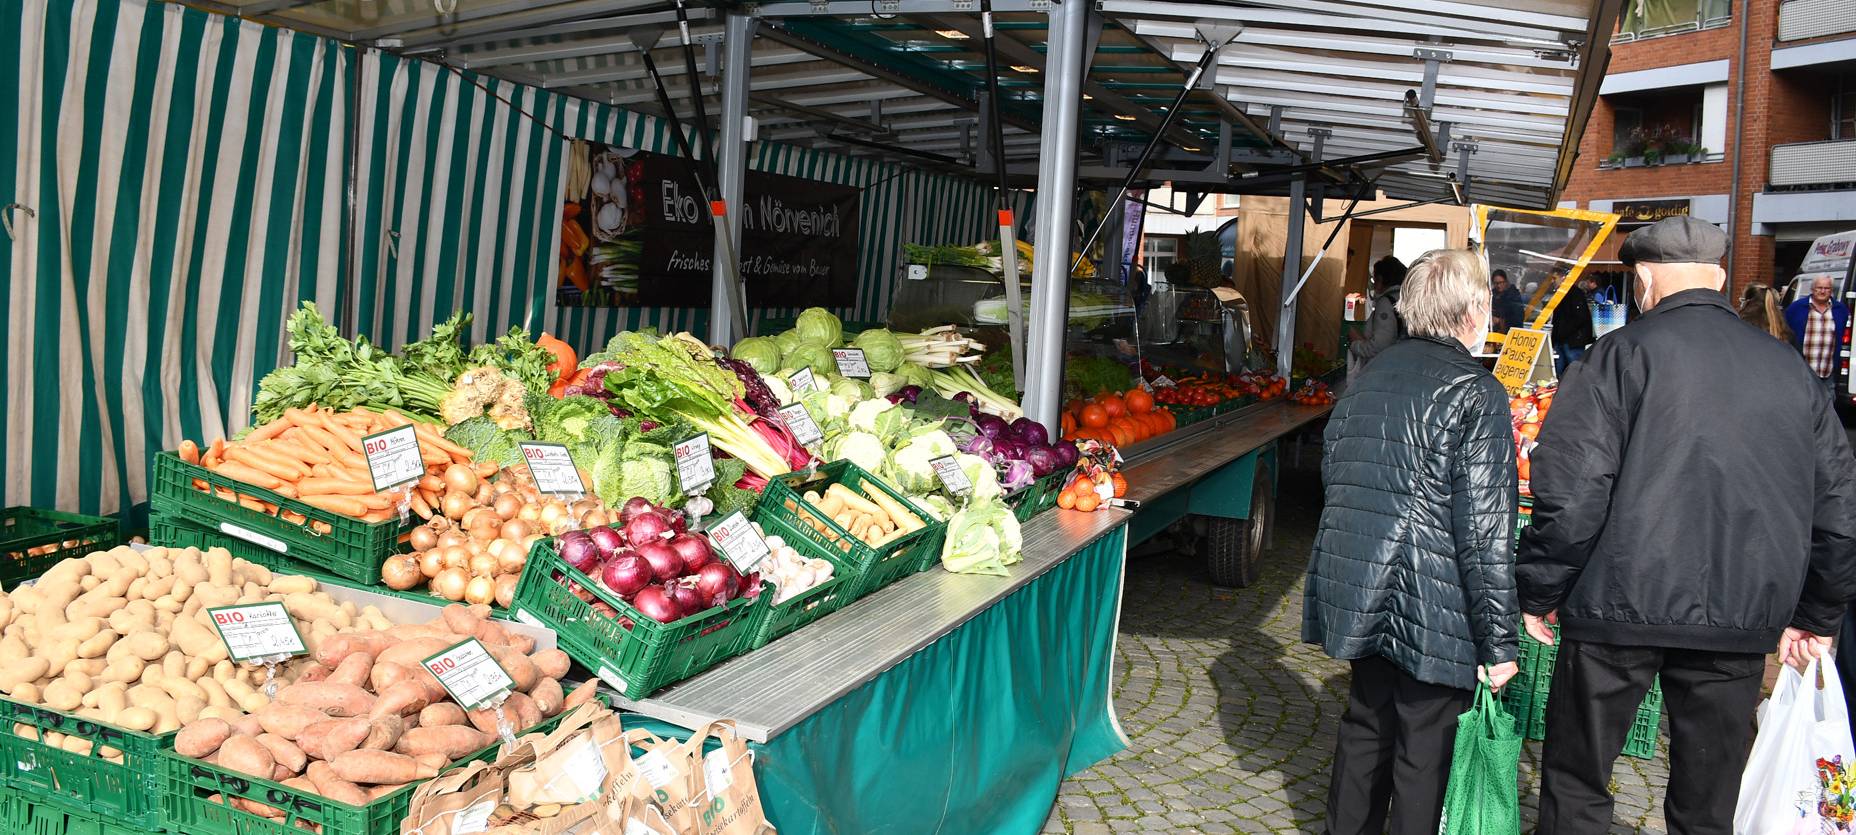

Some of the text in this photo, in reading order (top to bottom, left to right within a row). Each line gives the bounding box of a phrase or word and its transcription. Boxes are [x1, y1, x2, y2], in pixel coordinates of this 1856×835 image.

[662, 179, 699, 224] Eko
[760, 193, 840, 238] Nörvenich
[667, 249, 711, 272] frisches
[763, 256, 791, 275] Gemüse
[1510, 331, 1538, 352] Honig
[834, 351, 847, 359] BIO
[1508, 349, 1526, 362] aus
[1496, 364, 1529, 379] eigener
[781, 410, 793, 420] BIO
[366, 439, 387, 455] BIO
[524, 447, 544, 459] BIO
[676, 444, 690, 458] BIO
[931, 461, 944, 471] BIO
[713, 526, 730, 542] BIO
[214, 611, 245, 625] BIO
[430, 657, 456, 675] BIO
